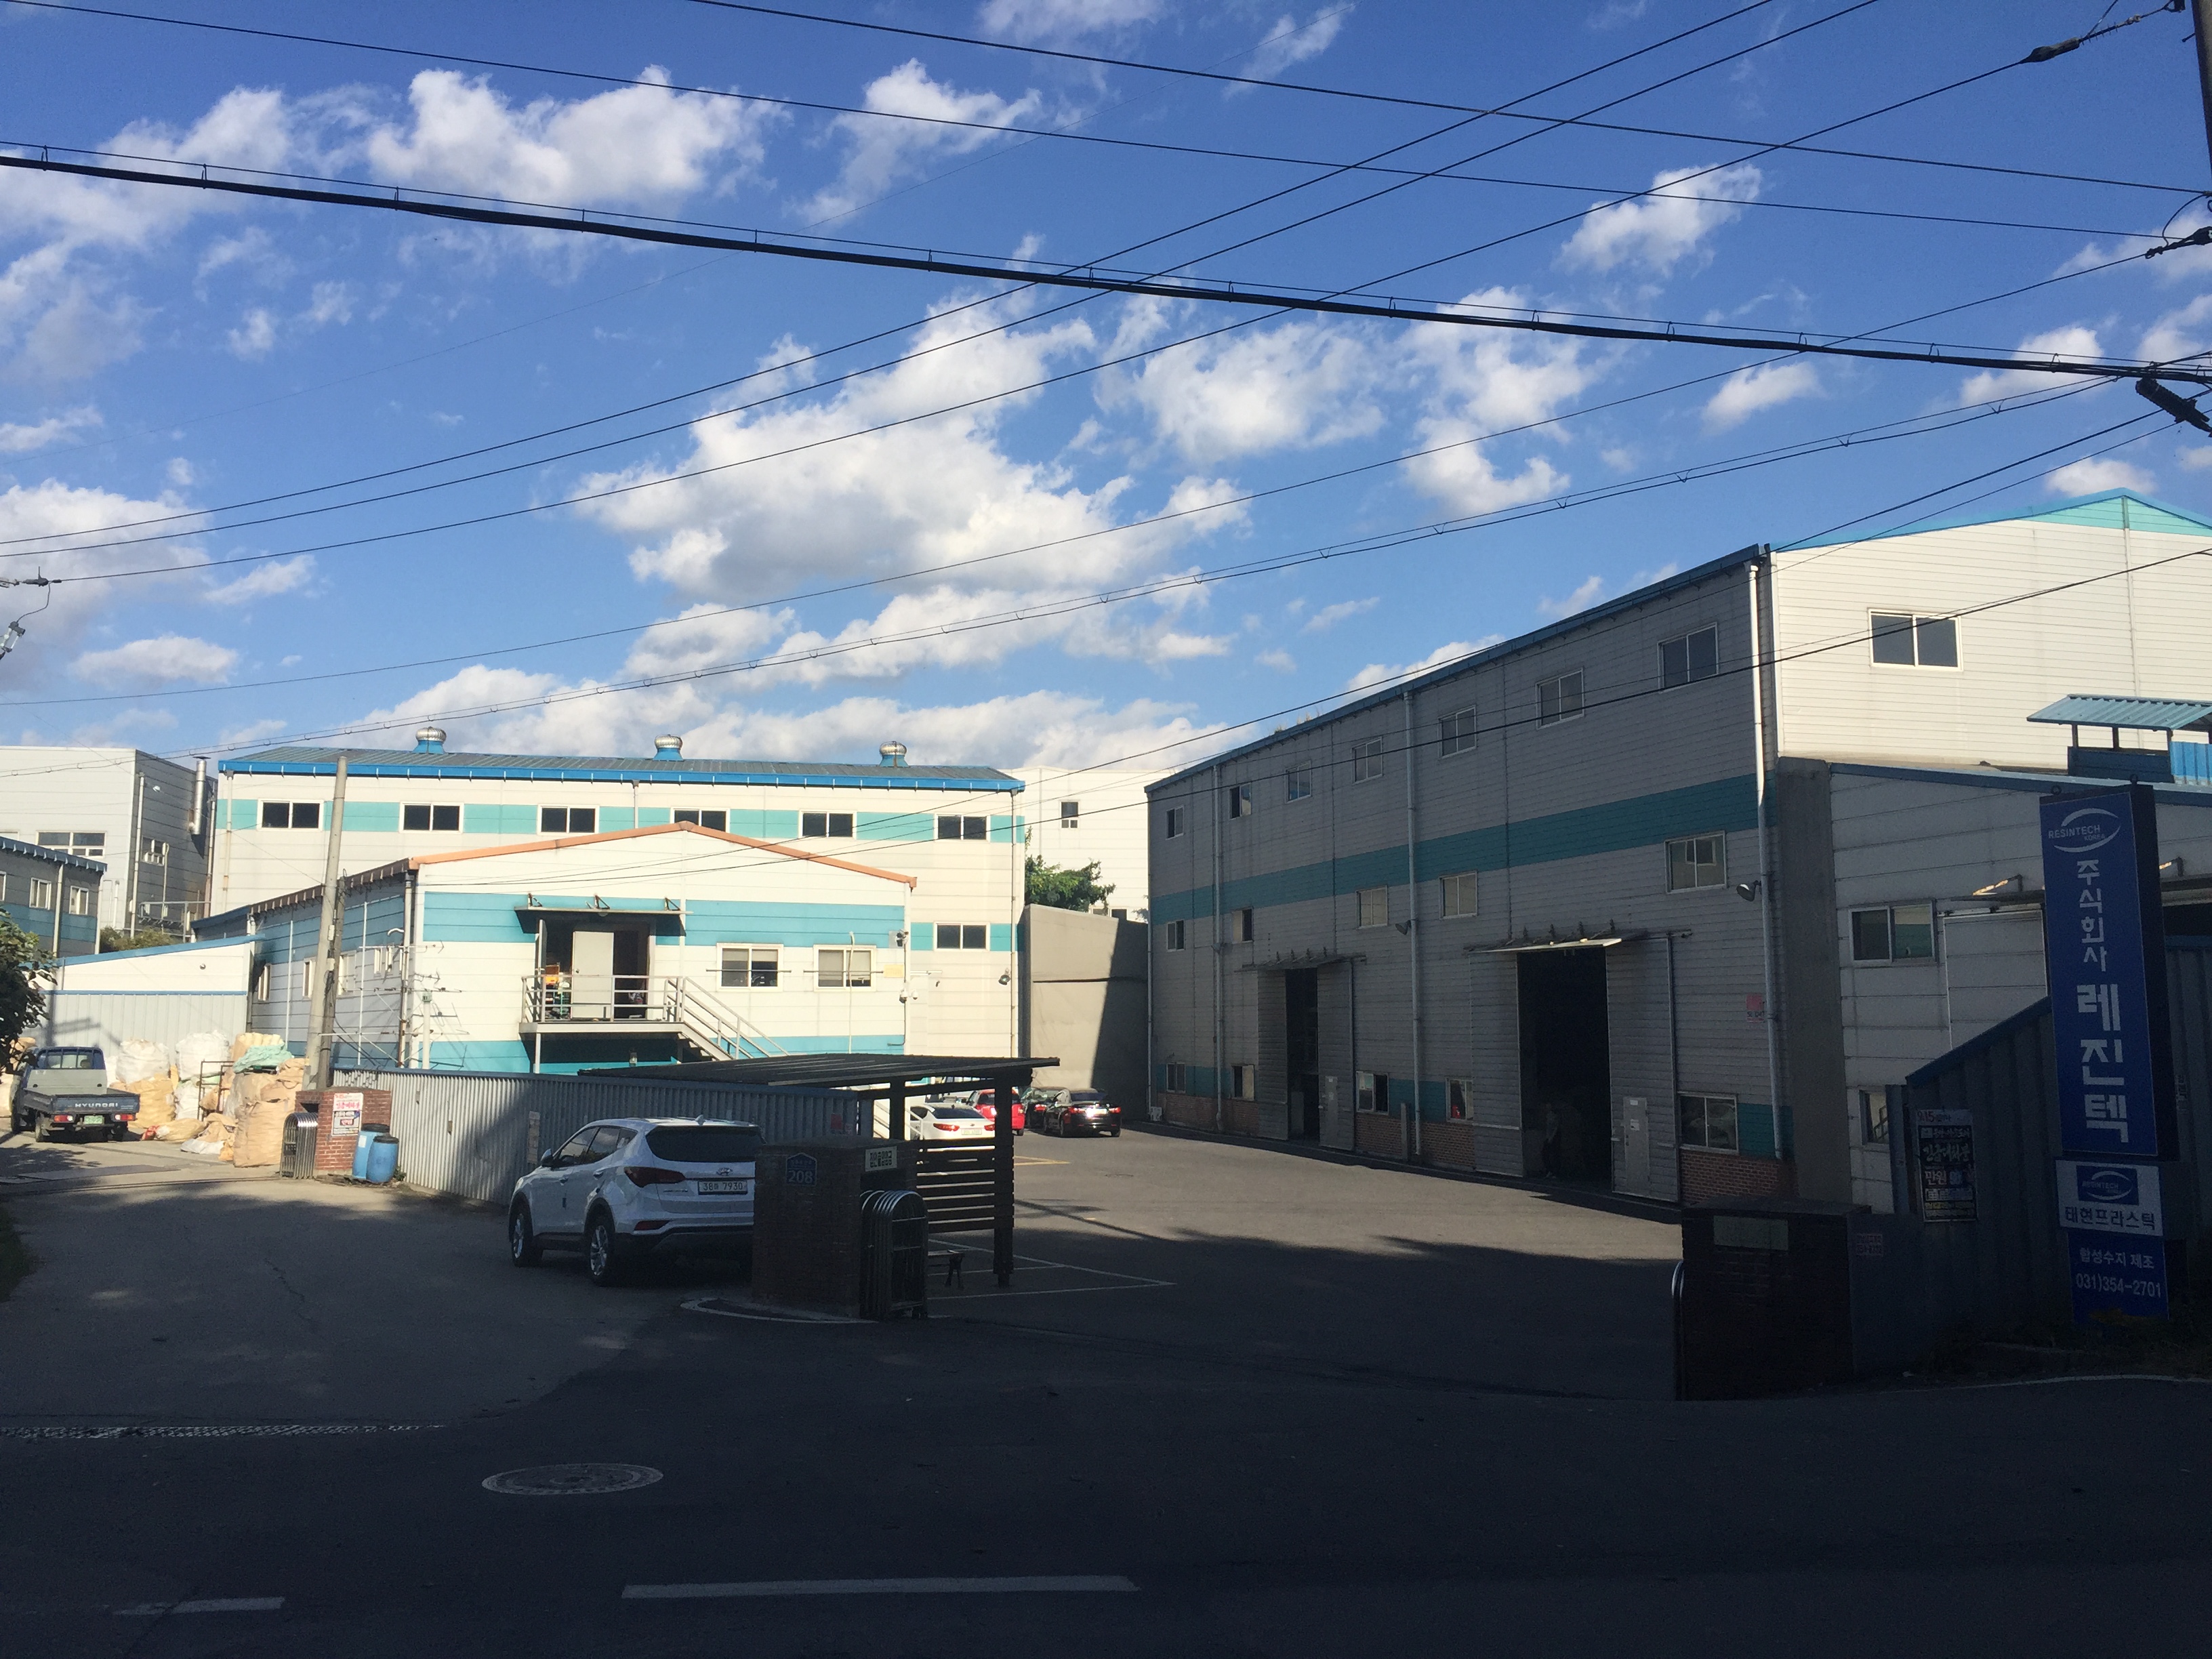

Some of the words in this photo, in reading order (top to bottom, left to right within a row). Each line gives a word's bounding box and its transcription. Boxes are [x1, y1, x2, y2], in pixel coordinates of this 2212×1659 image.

[2048, 825, 2100, 839] RESINTECH
[2076, 859, 2107, 972] 주식회사
[2076, 983, 2129, 1143] 레진텍
[722, 1182, 743, 1191] 7930
[788, 1170, 813, 1184] 208
[2065, 1206, 2155, 1231] 태현프라스틱
[2130, 1252, 2155, 1269] 제조
[2076, 1273, 2161, 1298] 031)354-2701
